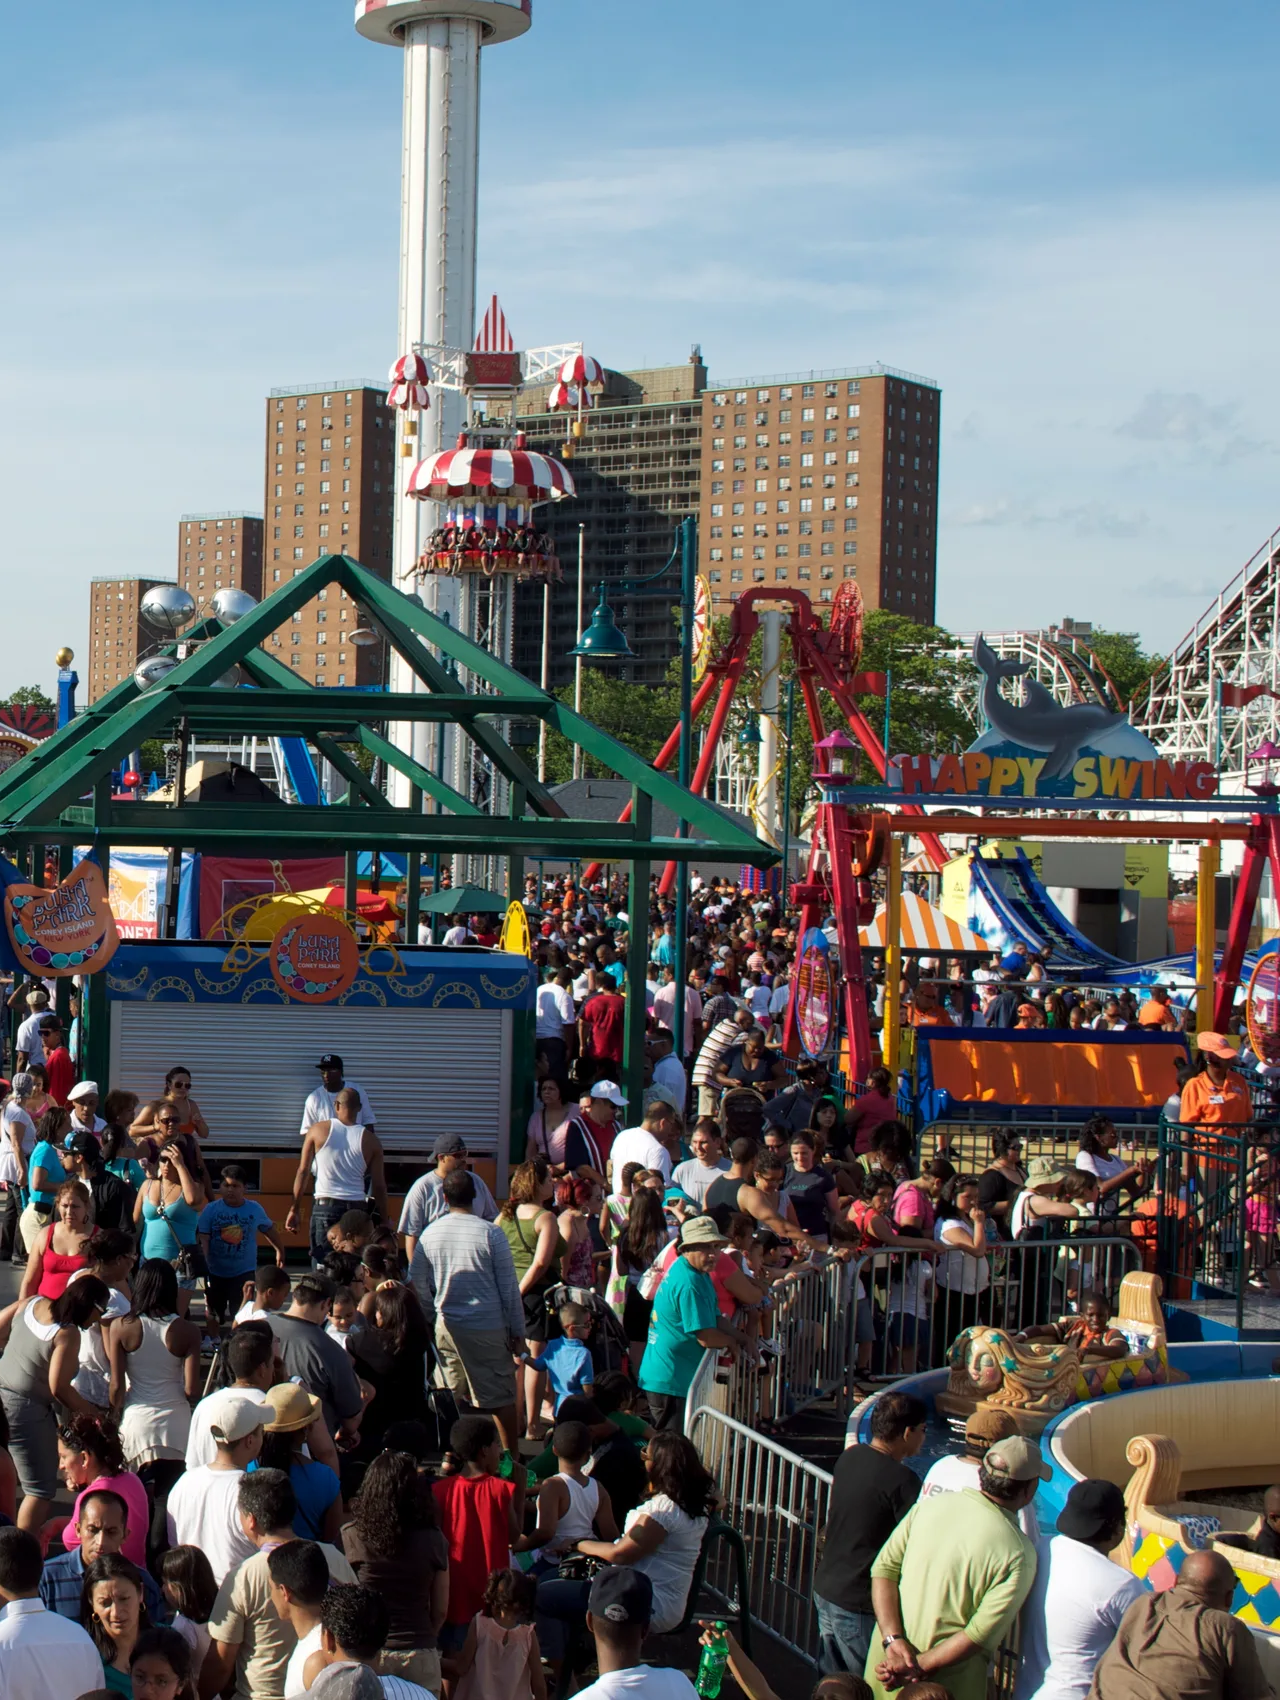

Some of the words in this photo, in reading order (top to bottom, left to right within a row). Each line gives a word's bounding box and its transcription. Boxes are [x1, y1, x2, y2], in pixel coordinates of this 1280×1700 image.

[900, 752, 1047, 798] HAPPY
[1072, 755, 1219, 800] SWING
[34, 927, 63, 937] CONEY
[64, 918, 95, 934] ISLAND
[44, 934, 64, 943] NEW
[298, 935, 339, 948] LUNA
[298, 947, 341, 963] PARK
